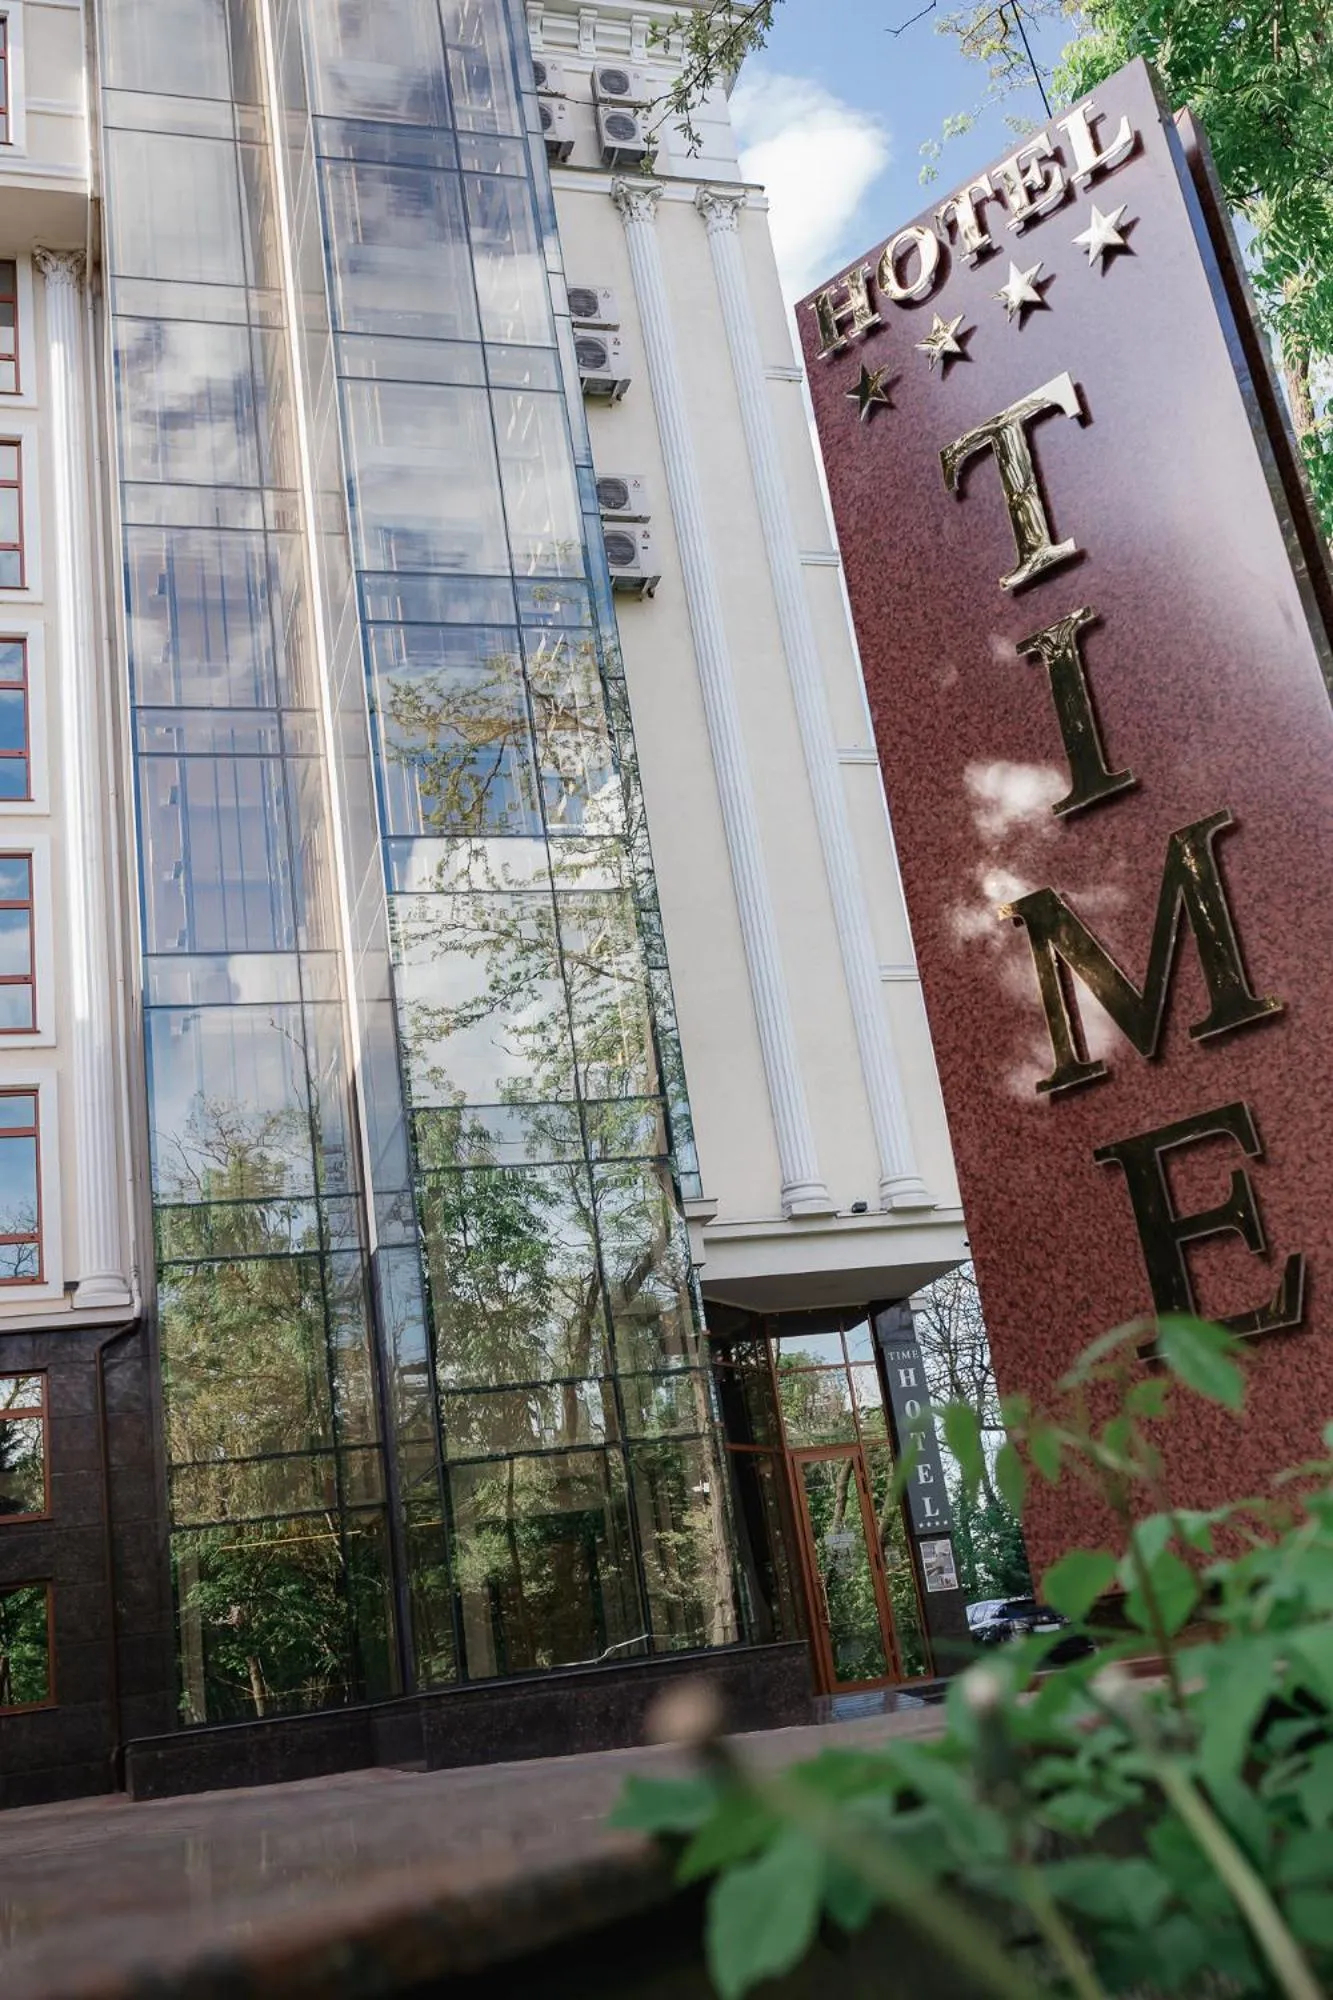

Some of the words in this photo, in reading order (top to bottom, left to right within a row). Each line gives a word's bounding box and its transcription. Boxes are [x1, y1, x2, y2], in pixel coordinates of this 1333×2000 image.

[808, 100, 1135, 361] HOTEL
[938, 371, 1306, 1362] TIME
[887, 1350, 918, 1361] TIME
[897, 1367, 940, 1518] HOTEL
